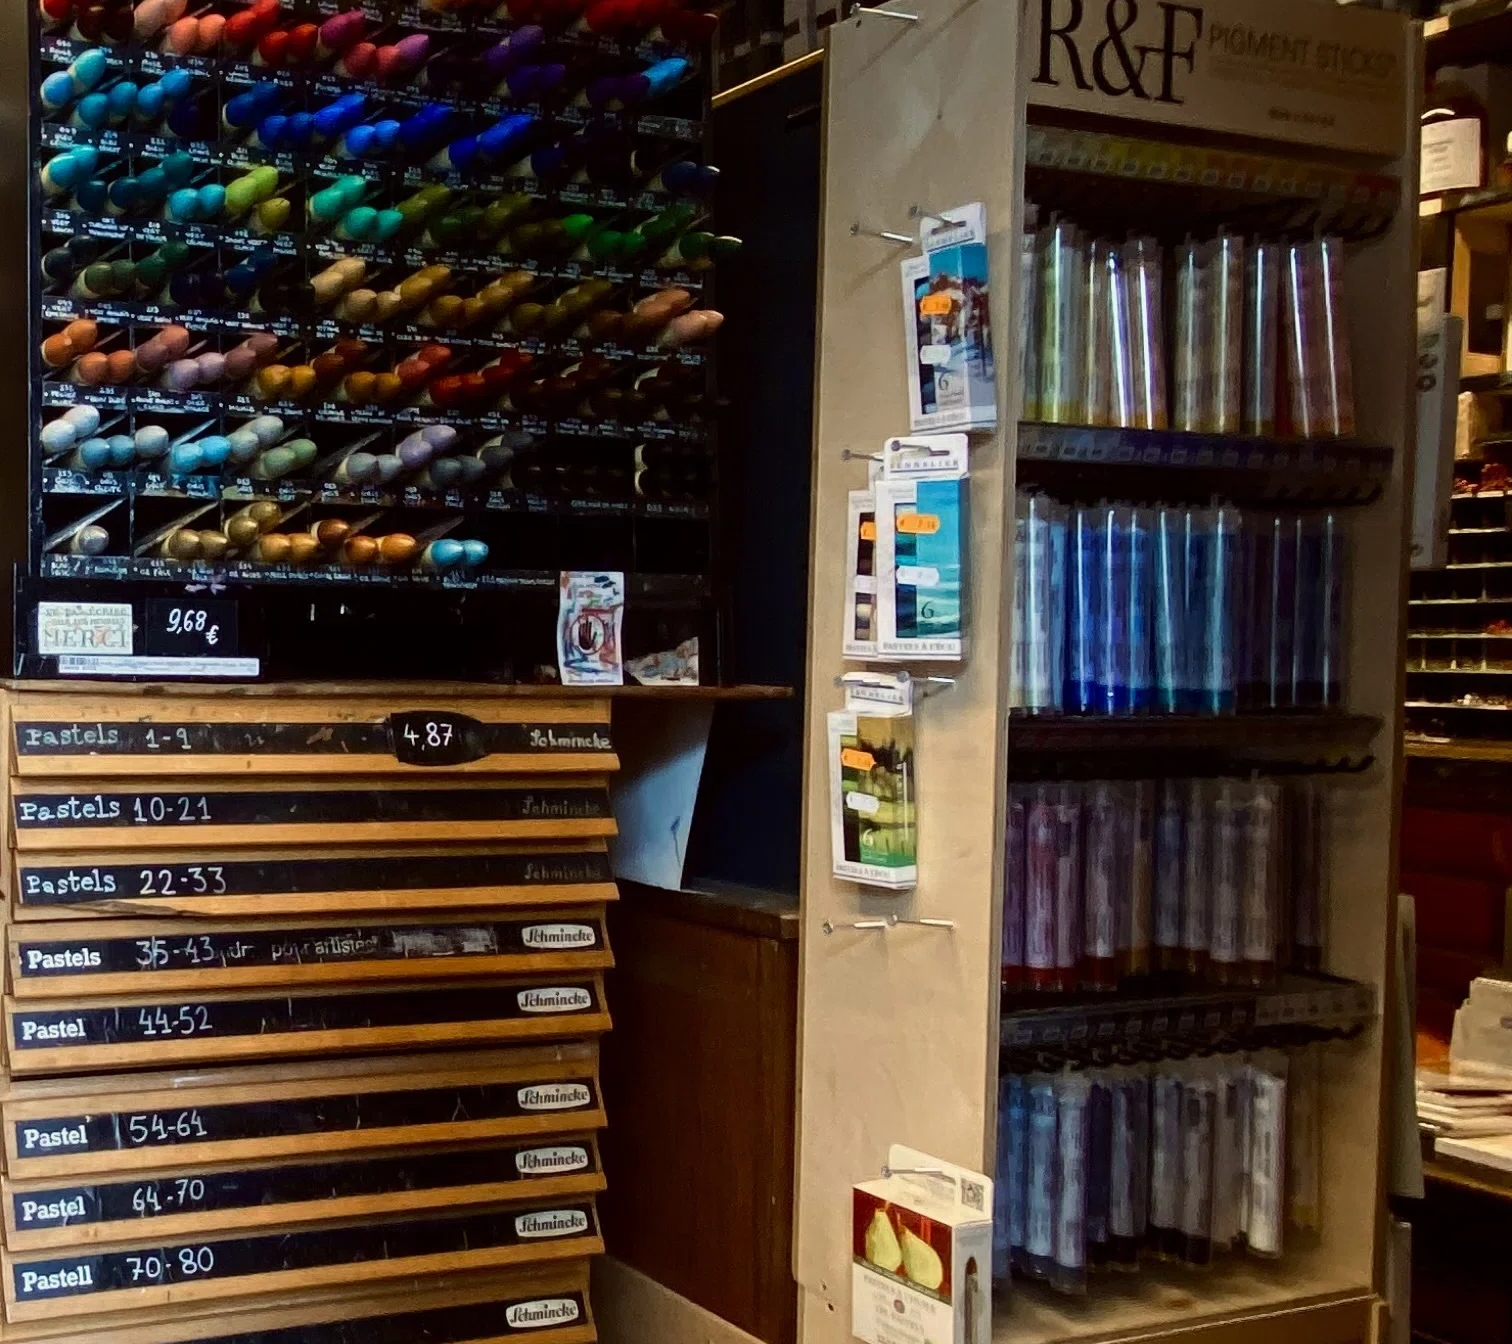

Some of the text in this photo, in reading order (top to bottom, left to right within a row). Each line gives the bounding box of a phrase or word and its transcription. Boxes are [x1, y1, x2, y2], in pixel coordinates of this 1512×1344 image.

[1208, 22, 1311, 66] PIGMENT
[939, 372, 949, 391] 6
[921, 600, 935, 620] 6
[44, 626, 129, 650] MERCI
[166, 608, 220, 646] 9,68 €
[25, 723, 192, 750] Pastels 1-9
[403, 721, 453, 752] 4,87
[530, 729, 612, 750] Schmincke
[19, 795, 212, 822] Pastels 10-21
[863, 827, 874, 846] 6
[26, 866, 226, 896] Pastels 22-33
[525, 927, 593, 944] Schmincke
[27, 947, 102, 970] Pastels
[520, 991, 589, 1008] Schmincke
[22, 1005, 213, 1041] Pastel 44-52
[520, 1087, 589, 1106] Schmincke
[24, 1109, 208, 1149] Pastel 54-64
[518, 1151, 586, 1170] Schmincke
[22, 1178, 205, 1222] Pastel 64-70
[518, 1215, 586, 1233] Schmincke
[22, 1265, 93, 1293] Pastell
[509, 1304, 578, 1323] Schmincke
